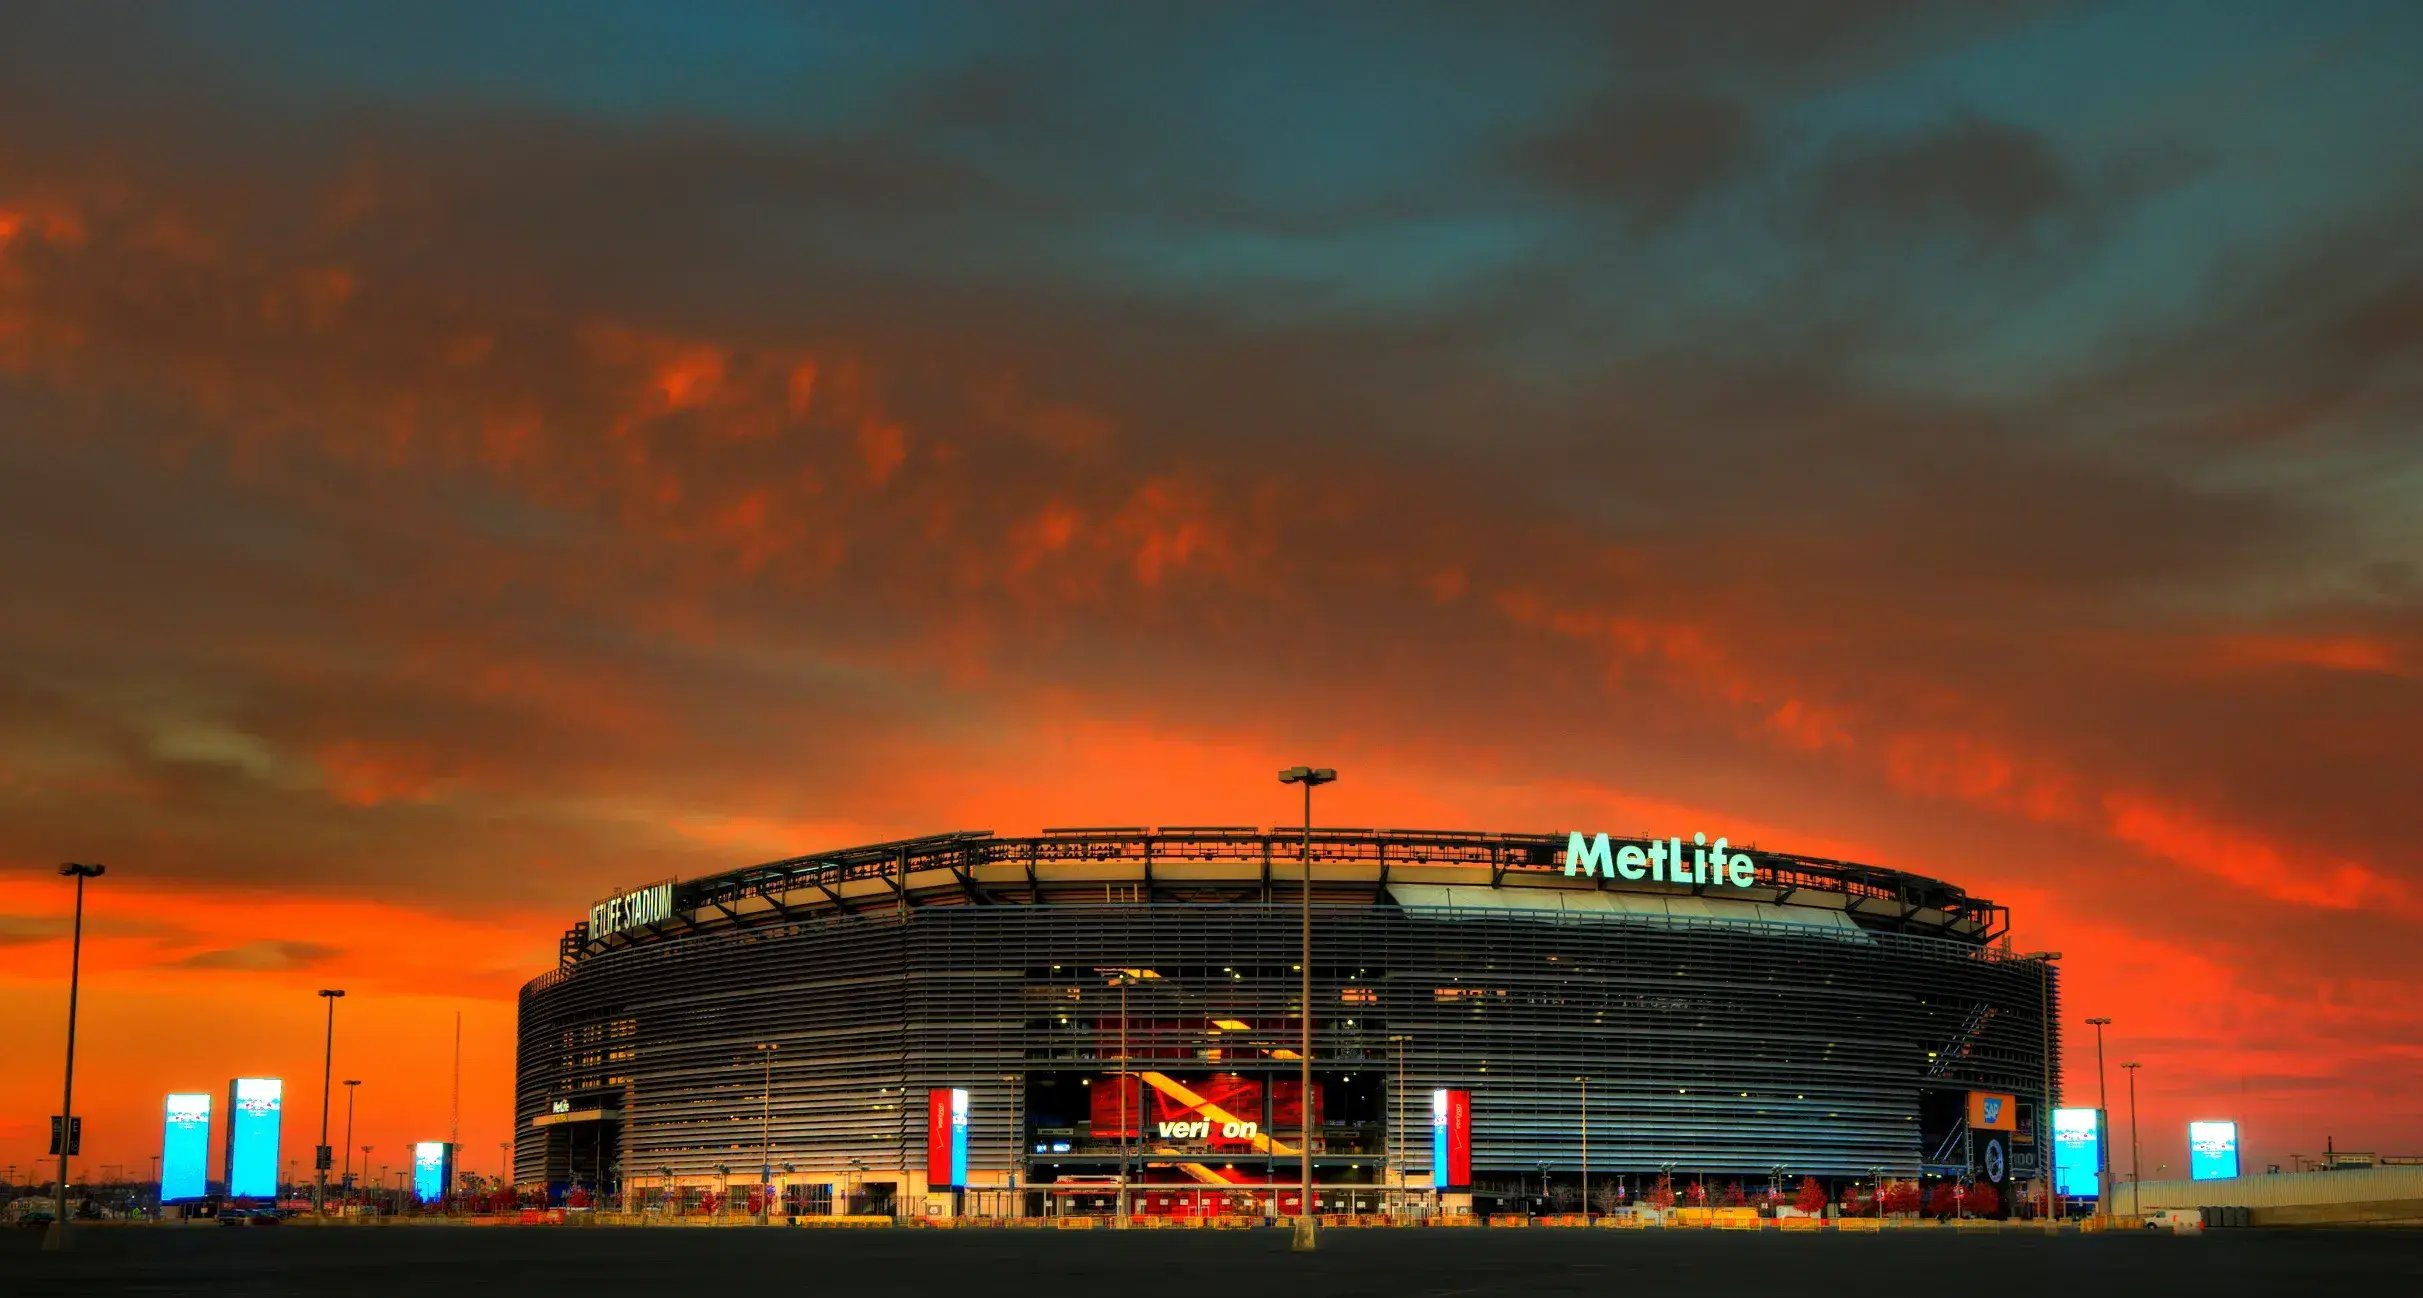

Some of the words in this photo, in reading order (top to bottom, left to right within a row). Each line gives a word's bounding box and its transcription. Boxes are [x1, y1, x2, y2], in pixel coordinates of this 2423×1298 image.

[1564, 831, 1755, 888] MetLife
[588, 897, 622, 941] METLIFE
[624, 882, 672, 930] STADIUM
[73, 1121, 79, 1132] E
[1984, 1102, 1998, 1119] SAP
